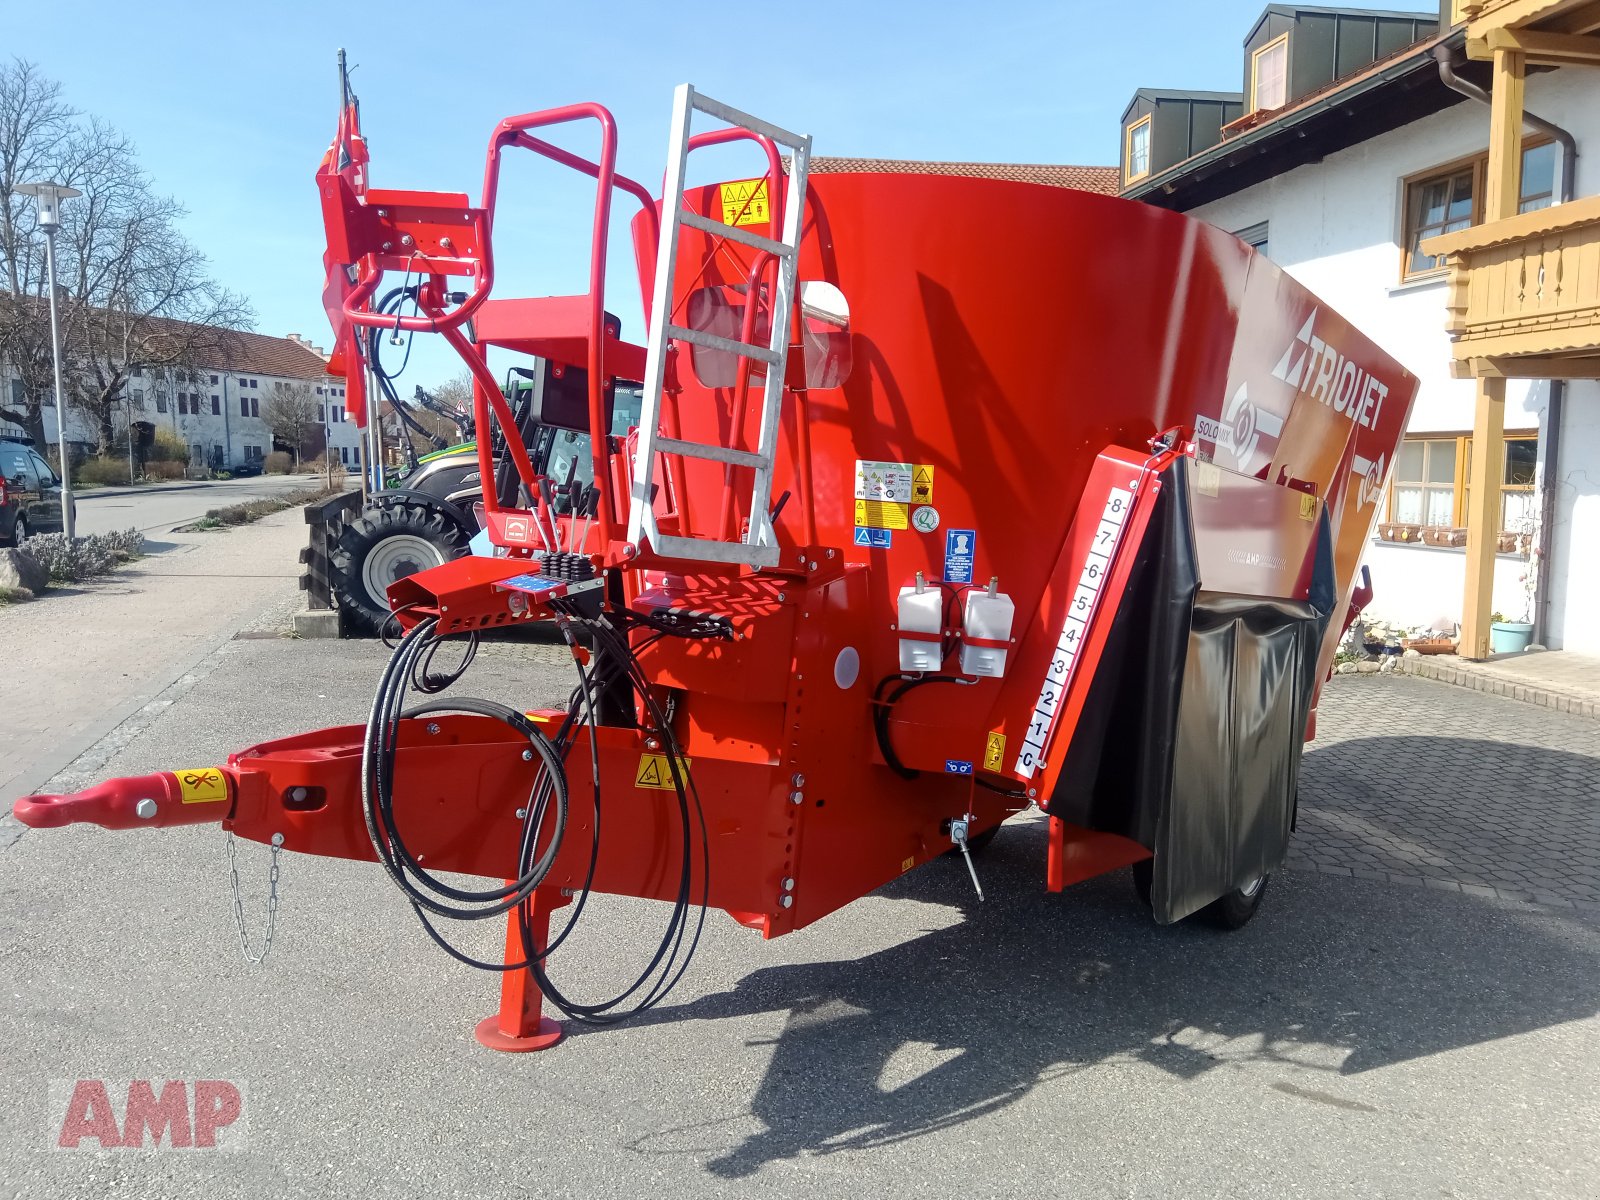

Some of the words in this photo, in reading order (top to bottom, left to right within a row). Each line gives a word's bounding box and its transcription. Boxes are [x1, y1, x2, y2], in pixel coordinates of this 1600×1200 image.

[1300, 335, 1389, 431] TRIOLIET
[1110, 498, 1123, 513] 8
[1100, 530, 1112, 545] 7
[1245, 552, 1260, 565] AMP
[1088, 563, 1100, 579] 6
[1076, 595, 1088, 611] 5
[1065, 629, 1076, 643] 4
[1054, 659, 1065, 674] 3
[1043, 691, 1055, 706] 2
[1034, 722, 1043, 736] 1
